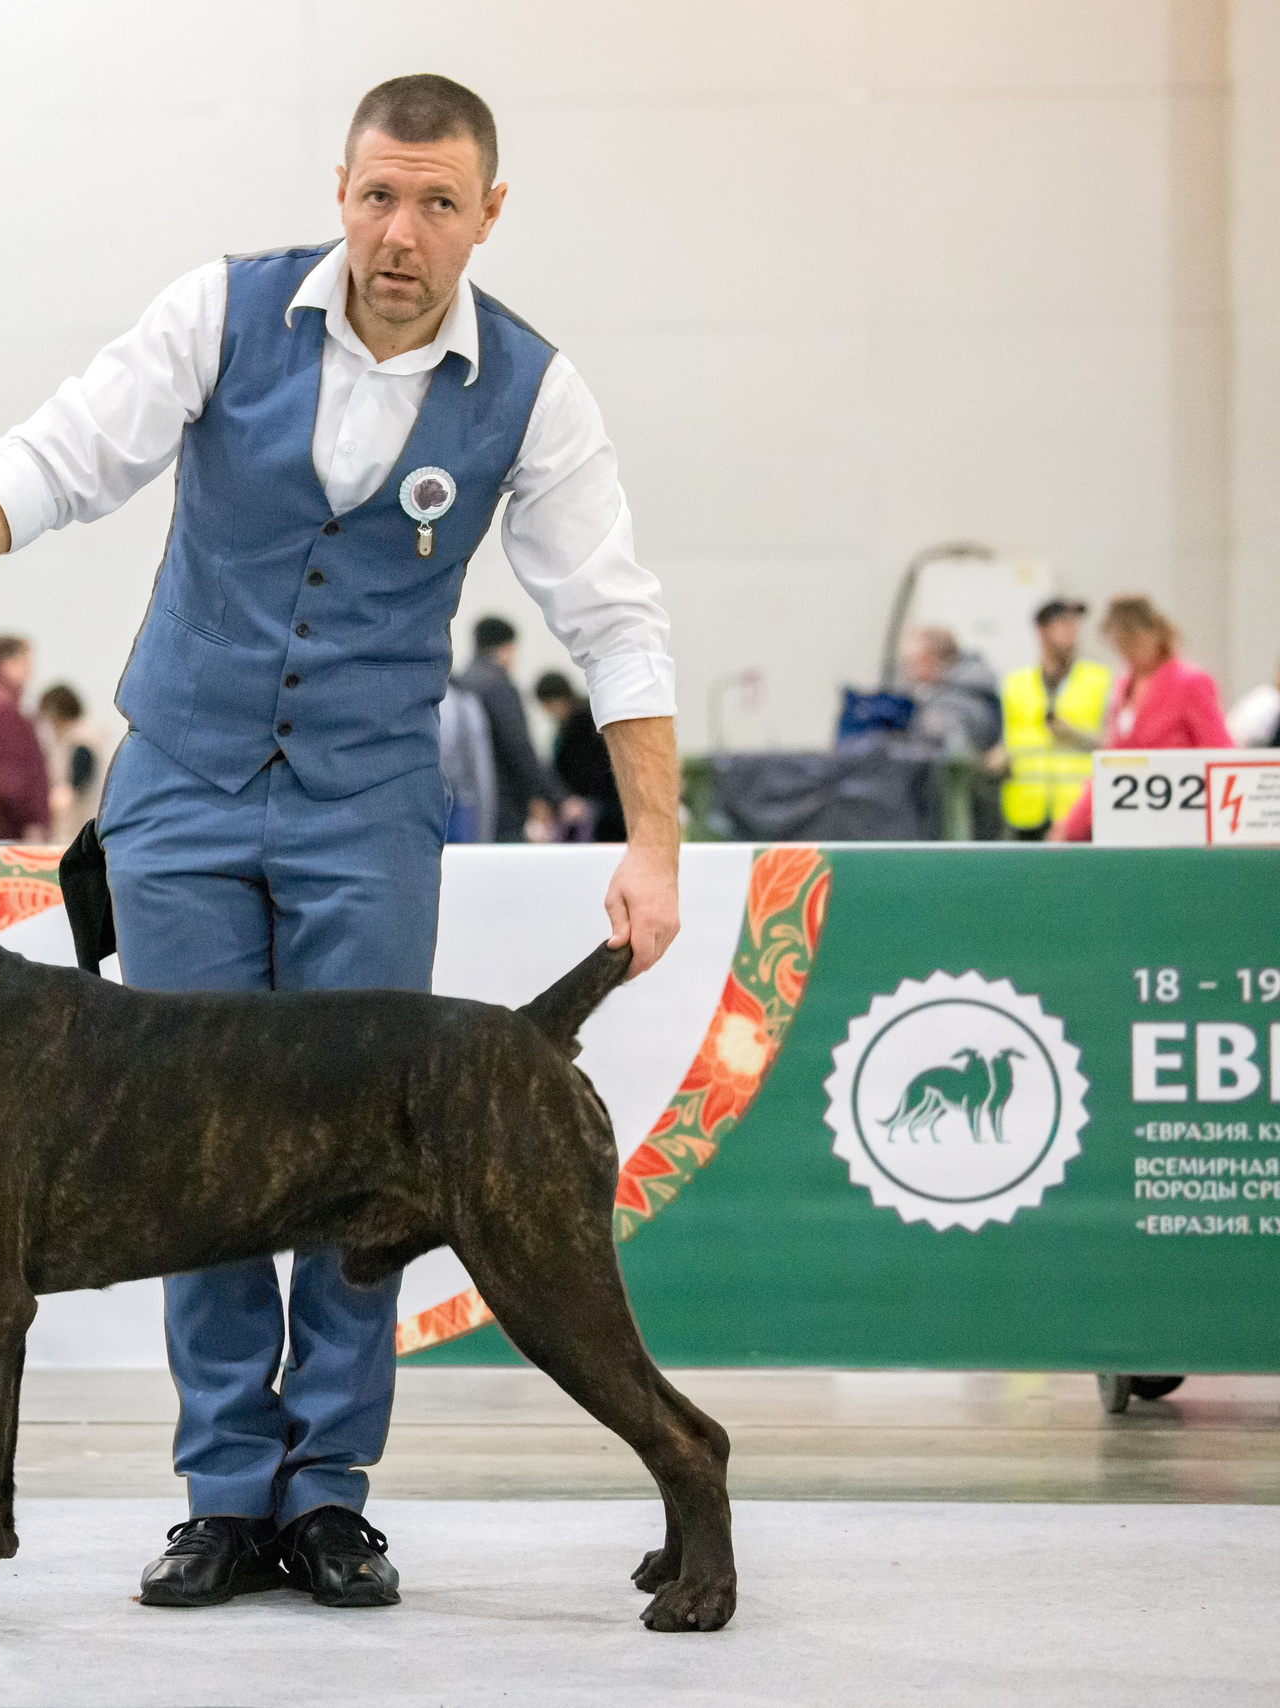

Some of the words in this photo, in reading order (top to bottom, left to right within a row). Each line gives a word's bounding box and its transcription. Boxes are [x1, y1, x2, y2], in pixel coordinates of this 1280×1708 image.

[1112, 774, 1206, 811] 292
[1133, 967, 1180, 1002] 18
[1236, 967, 1280, 1003] 19
[1130, 1021, 1280, 1103] ЕВ
[1134, 1156, 1280, 1177] ВСЕМИРНАЯ
[1134, 1180, 1238, 1201] ПОРОДЫ
